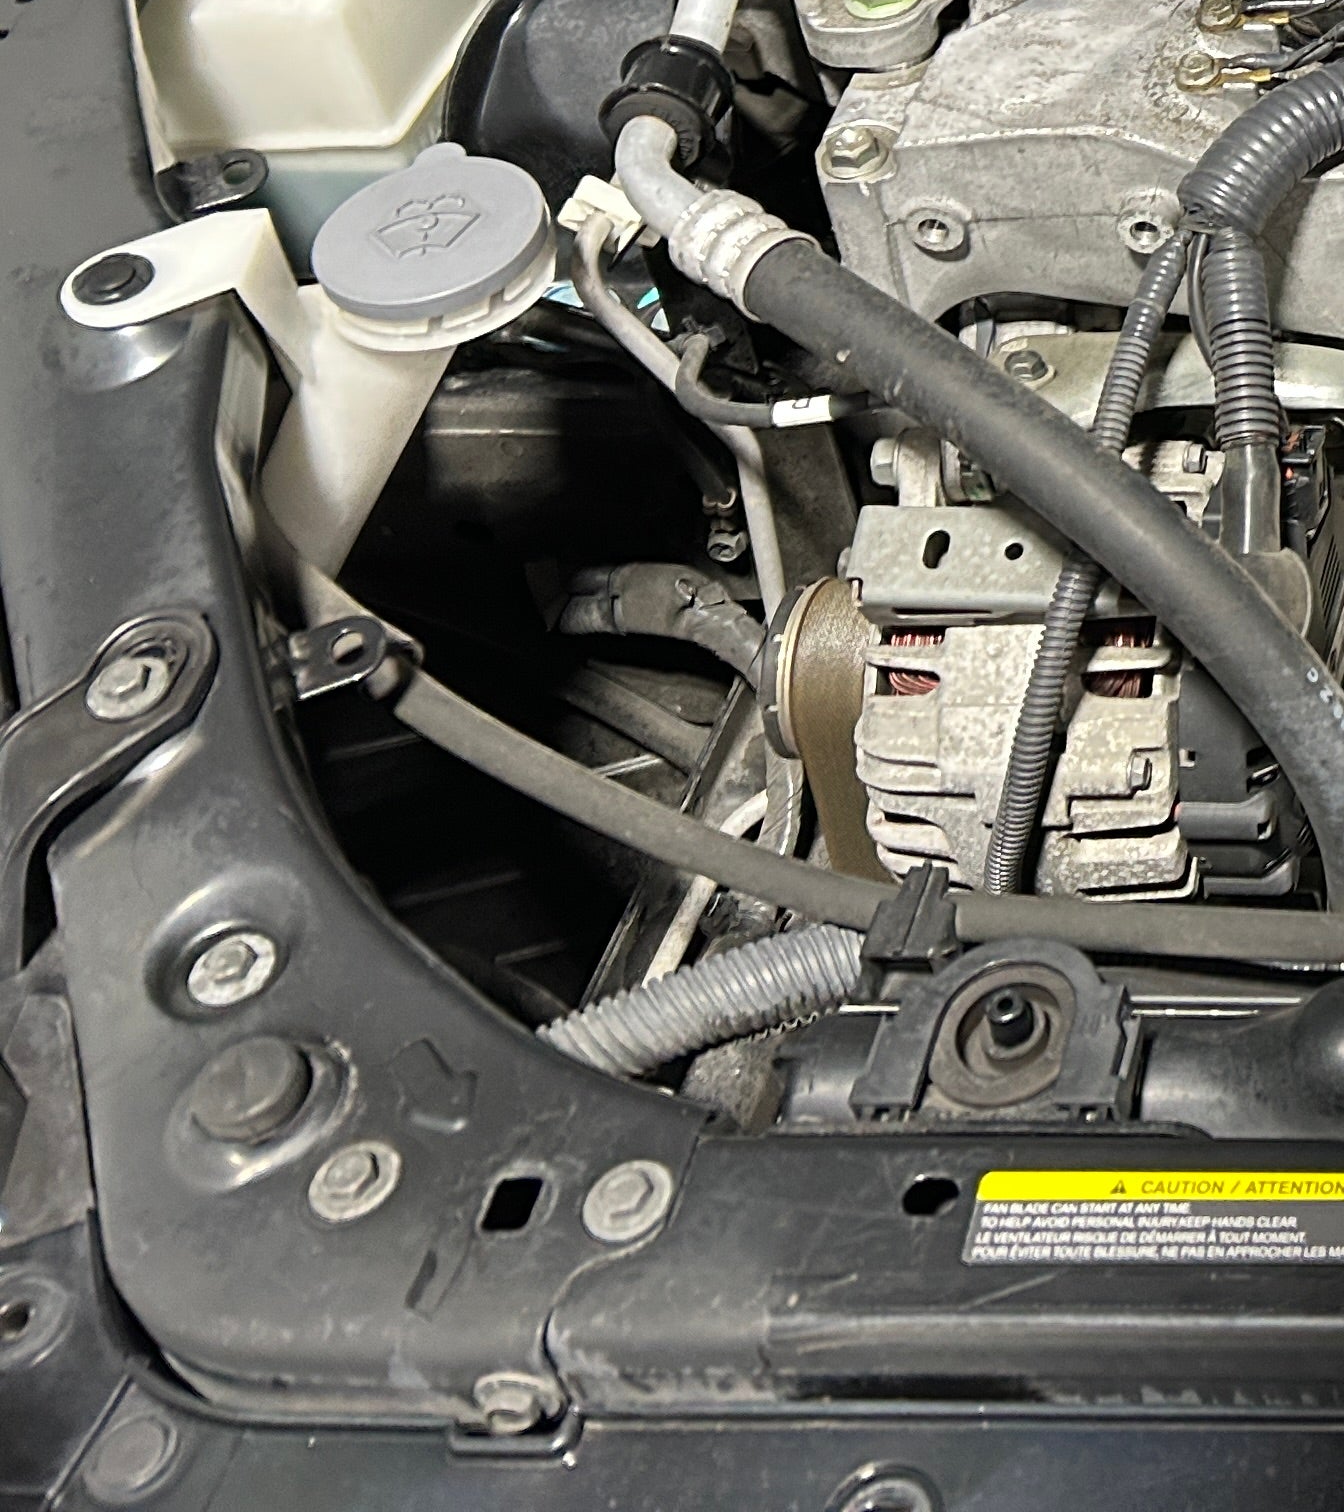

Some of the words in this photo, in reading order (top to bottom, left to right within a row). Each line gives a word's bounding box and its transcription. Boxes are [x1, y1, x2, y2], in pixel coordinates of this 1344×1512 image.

[1140, 1180, 1226, 1195] CAUTION
[983, 1202, 1008, 1214] FAN
[1010, 1202, 1049, 1214] BLADE
[1051, 1202, 1077, 1214] CAN
[1079, 1202, 1116, 1214] START
[1117, 1202, 1134, 1214] AT
[1134, 1202, 1161, 1214] ANY
[980, 1216, 998, 1228] TO
[999, 1216, 1031, 1228] HELP
[1032, 1216, 1069, 1228] AVOID
[1072, 1216, 1135, 1229] PERSONAL
[1178, 1216, 1211, 1228] KEEP
[1211, 1216, 1255, 1229] HANDS
[975, 1232, 993, 1244] LE
[993, 1231, 1071, 1244] VENTILATEUR
[1120, 1231, 1137, 1245] DE
[1219, 1231, 1251, 1244] TOUT
[971, 1246, 1008, 1259] POUR
[1010, 1244, 1052, 1259] ÉVITER
[1053, 1246, 1092, 1259] TOUTE
[1161, 1246, 1179, 1259] NE
[1180, 1246, 1205, 1259] PAS
[1207, 1246, 1225, 1259] EN
[1227, 1246, 1302, 1259] APPROCHER
[1304, 1246, 1327, 1259] LES
